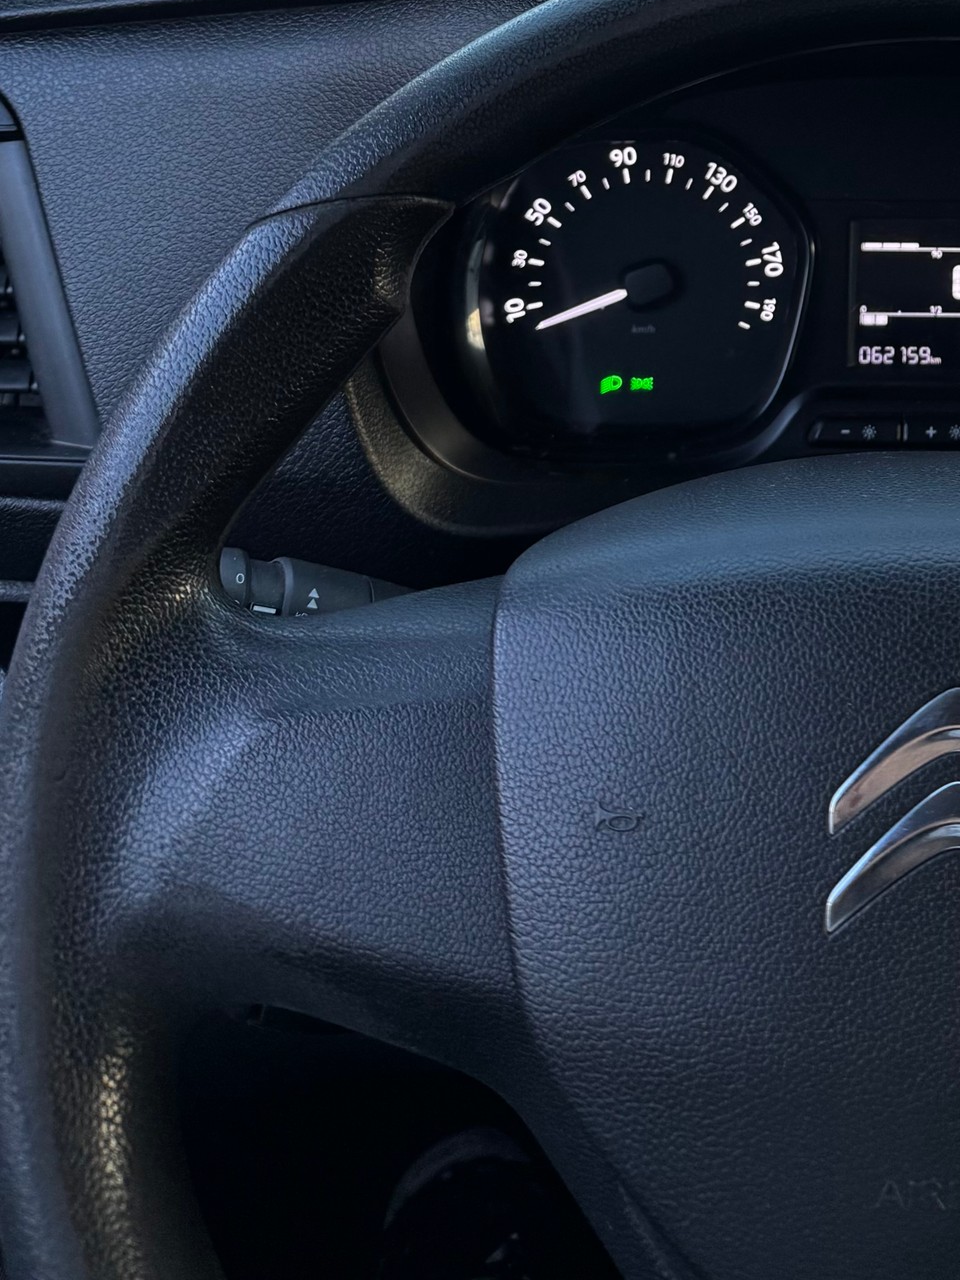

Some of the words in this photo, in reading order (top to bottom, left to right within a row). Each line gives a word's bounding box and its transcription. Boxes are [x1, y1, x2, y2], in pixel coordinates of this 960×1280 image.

[609, 146, 637, 168] 90
[662, 152, 685, 169] 110
[567, 169, 587, 188] 70
[704, 161, 738, 193] 130
[523, 197, 552, 227] 50
[742, 202, 763, 227] 150
[511, 249, 528, 269] 30
[761, 241, 784, 278] 170
[503, 297, 526, 324] 10
[759, 297, 777, 322] 190
